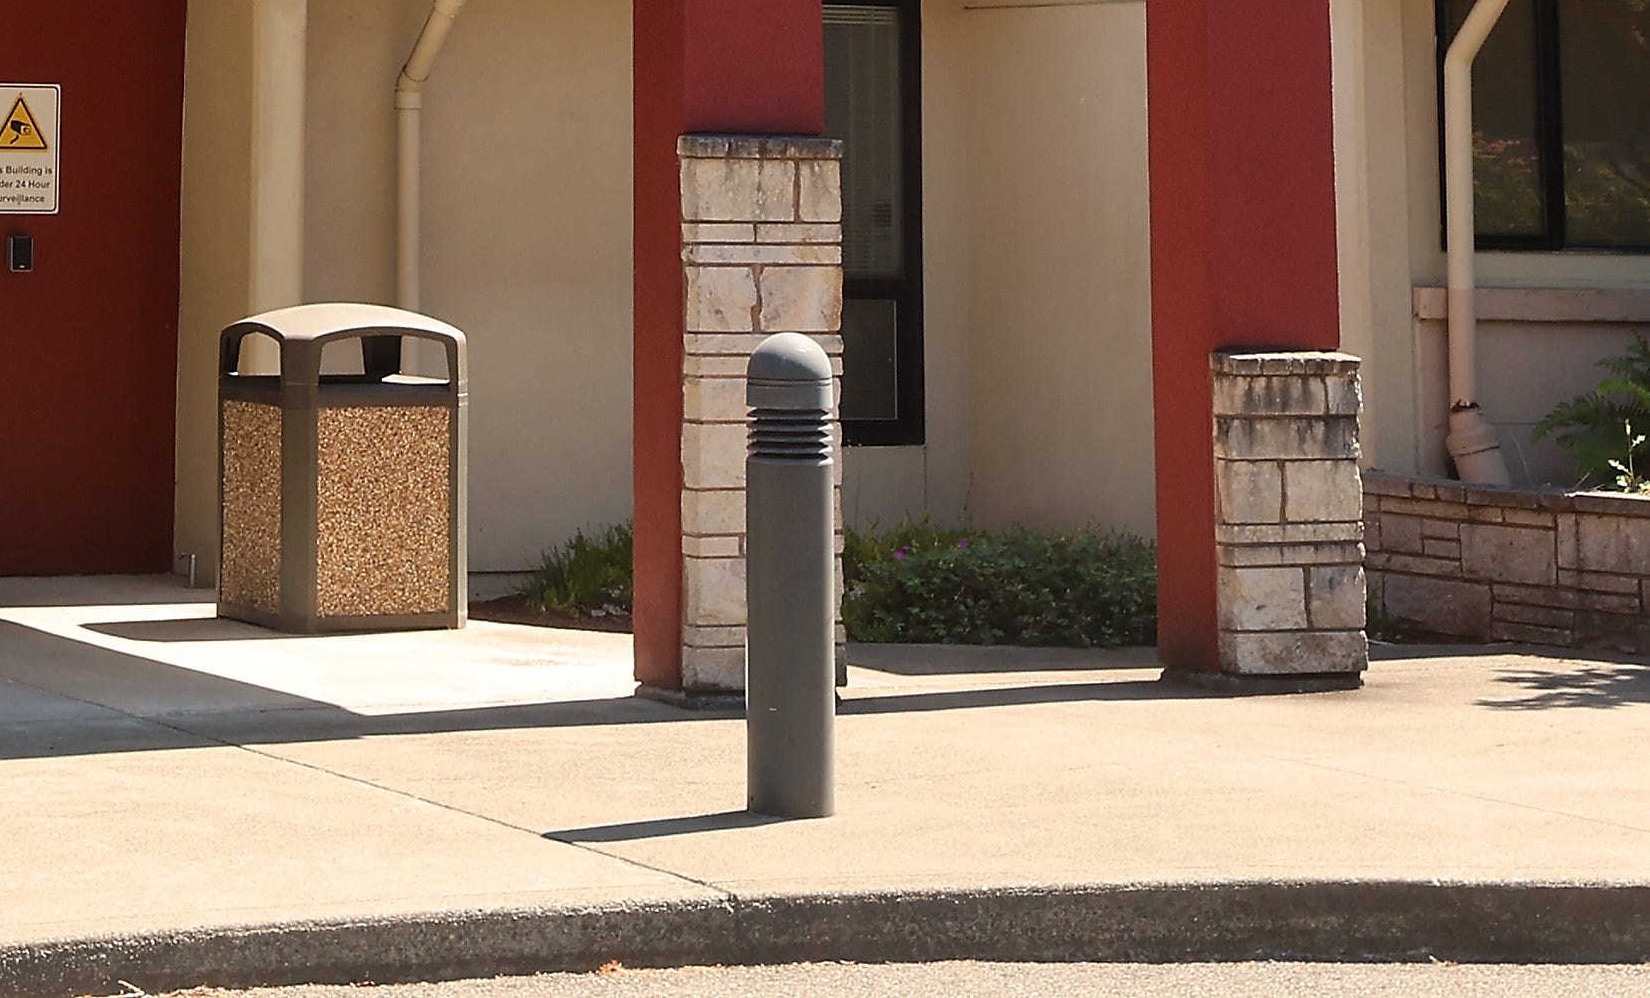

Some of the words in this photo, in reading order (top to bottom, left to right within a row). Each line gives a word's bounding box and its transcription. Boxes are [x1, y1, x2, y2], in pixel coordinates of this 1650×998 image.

[5, 165, 43, 176] Building
[45, 166, 53, 174] is
[15, 180, 26, 188] 24
[28, 180, 50, 189] Hour
